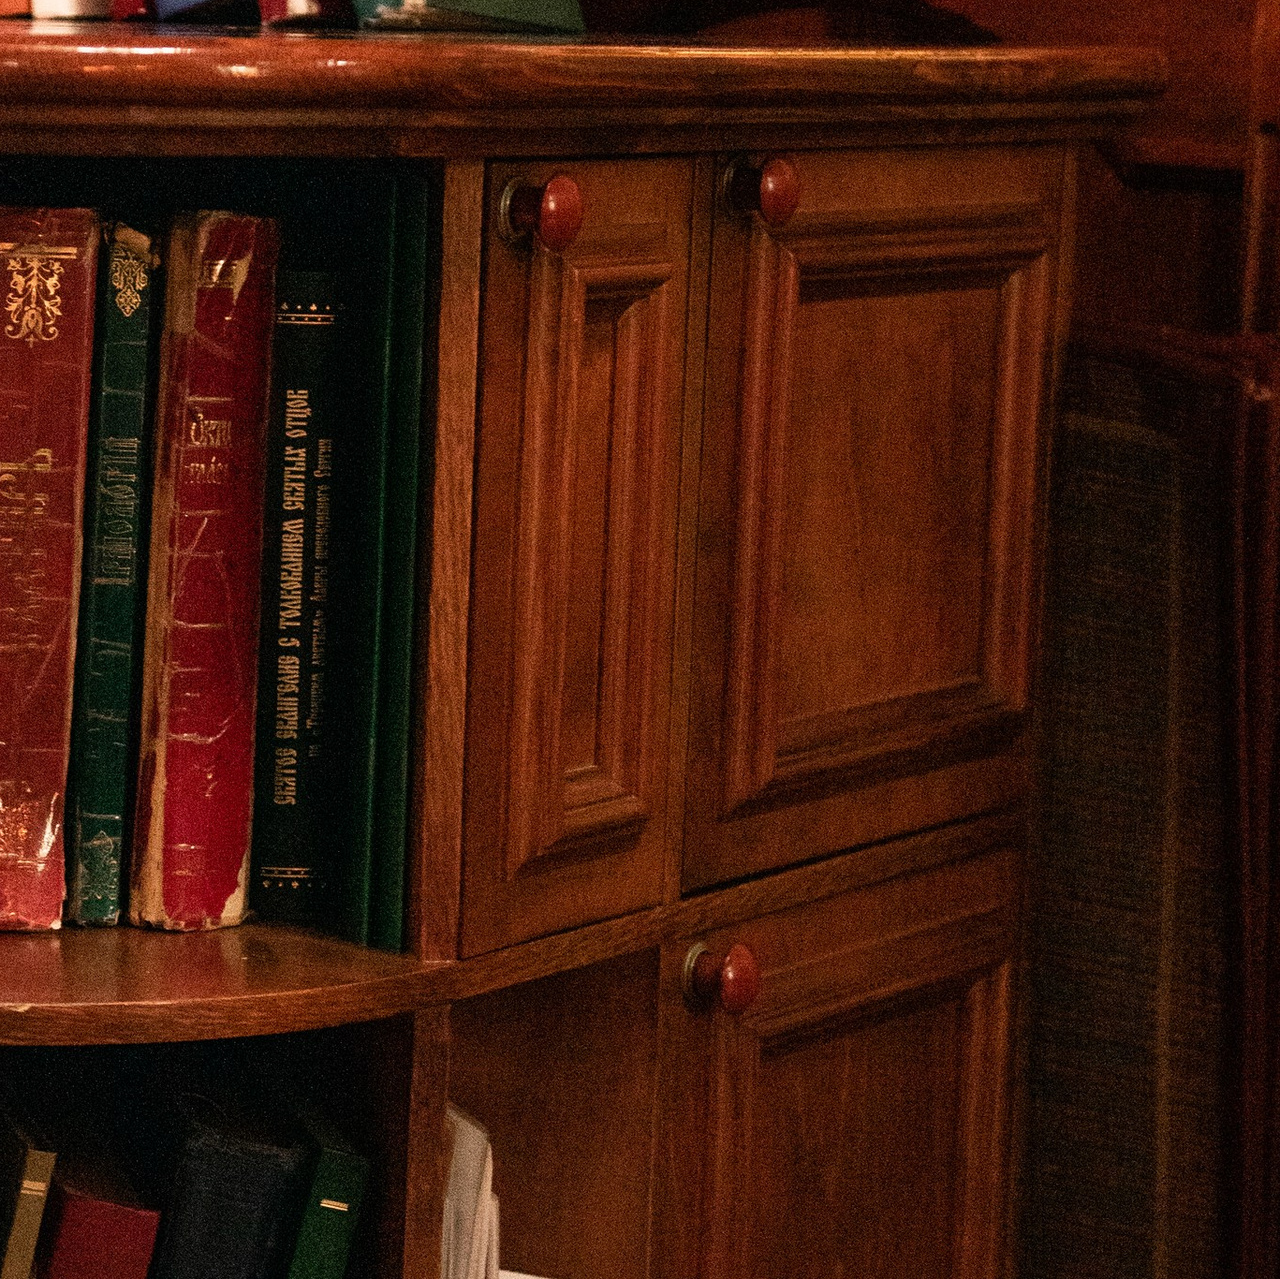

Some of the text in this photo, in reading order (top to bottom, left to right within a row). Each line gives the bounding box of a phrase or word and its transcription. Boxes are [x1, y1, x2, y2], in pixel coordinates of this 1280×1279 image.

[272, 387, 312, 805] СВЯТОЕ ЕВАНГЕЛИЕ С ТОЛКОВАНИЕМ СВЯТЫХ ОТЦОВ
